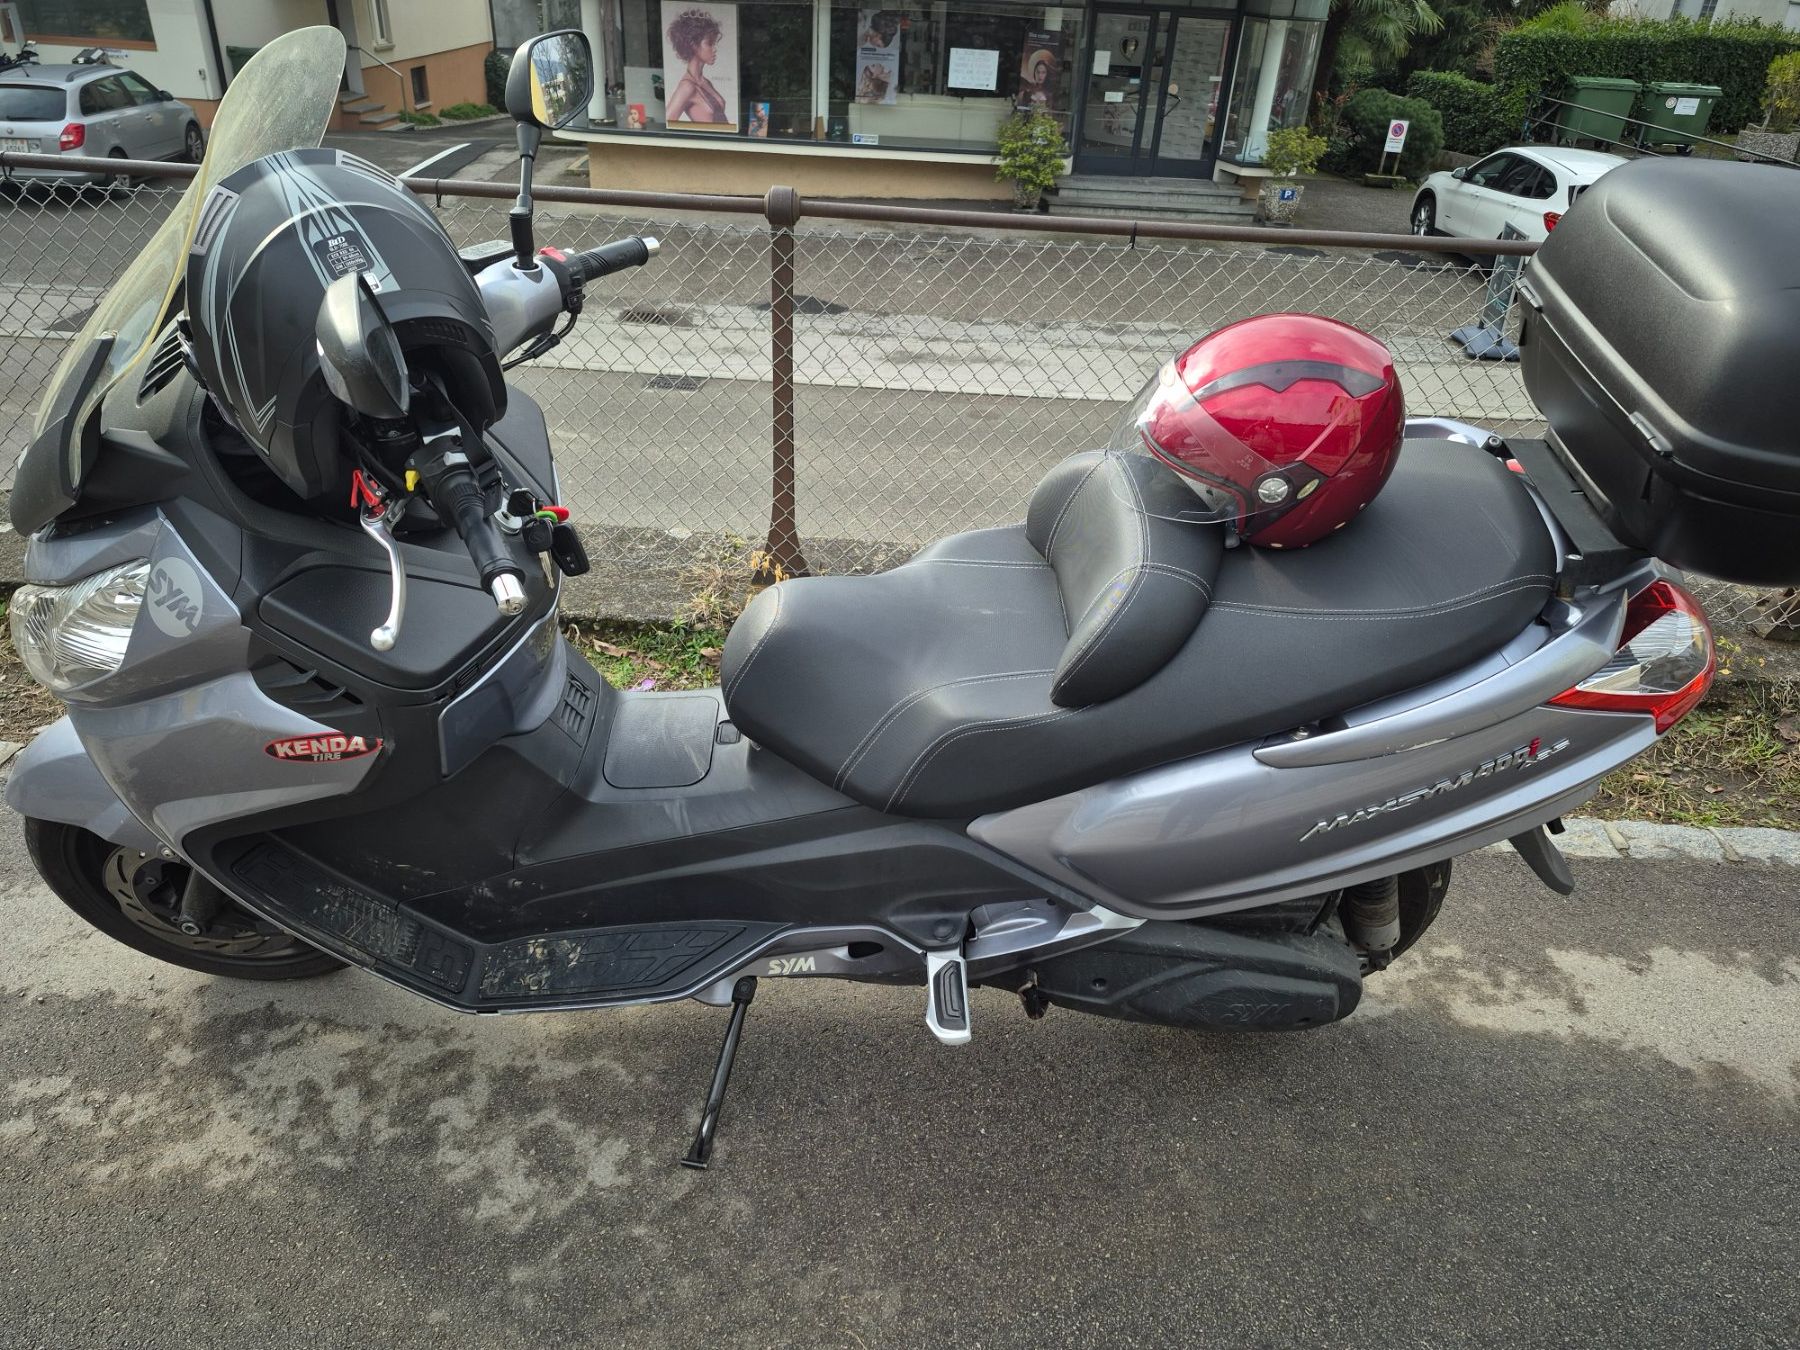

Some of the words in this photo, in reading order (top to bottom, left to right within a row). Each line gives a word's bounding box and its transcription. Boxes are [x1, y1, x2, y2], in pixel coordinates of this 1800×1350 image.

[1284, 190, 1292, 199] P
[149, 567, 199, 633] SYM
[274, 735, 368, 757] KENDA
[311, 752, 342, 762] TIRE
[767, 956, 816, 976] SYM
